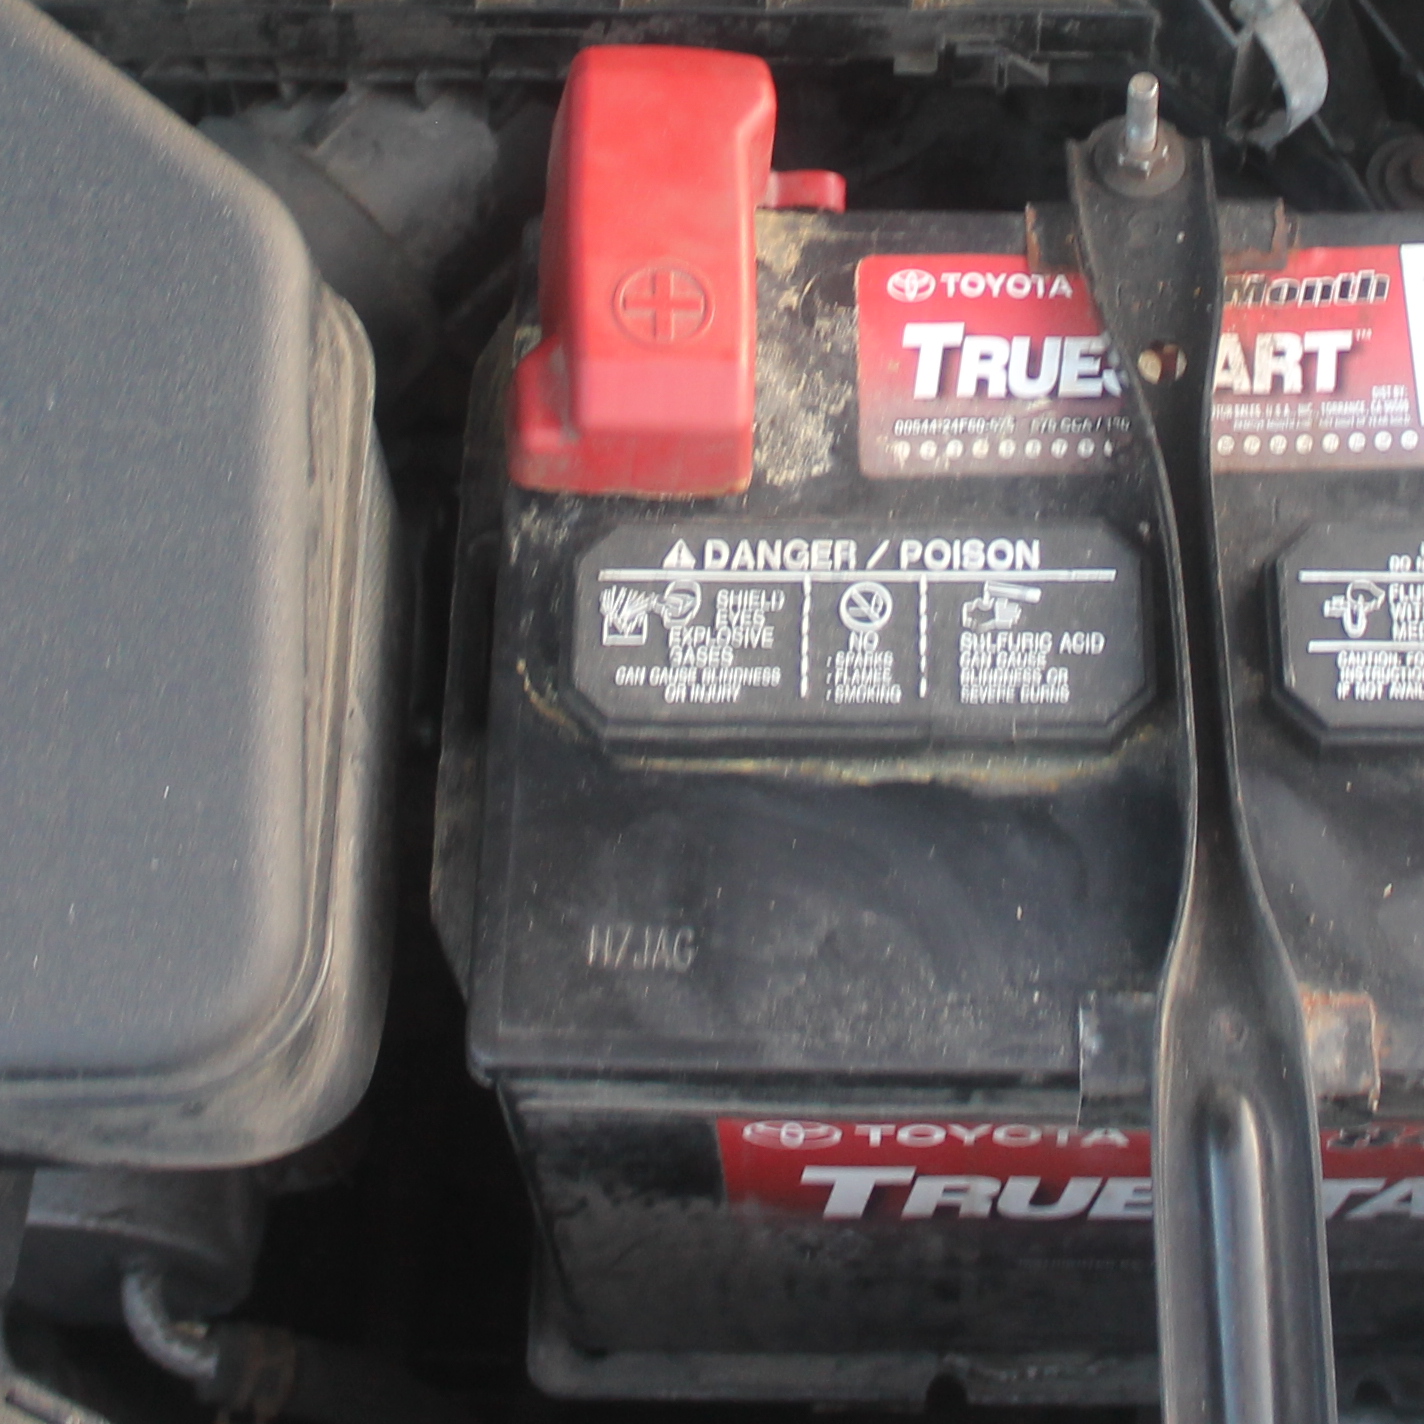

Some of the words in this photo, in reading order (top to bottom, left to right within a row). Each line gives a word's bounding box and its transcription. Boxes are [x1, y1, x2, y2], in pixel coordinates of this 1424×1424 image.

[940, 271, 1074, 299] TOYOTA
[704, 539, 858, 570] DANGER
[899, 539, 1040, 570] POISON
[716, 589, 785, 611] SHIELD
[716, 609, 766, 628] EYES
[668, 626, 775, 649] EXPLOSIVE
[849, 631, 879, 652] NO
[960, 631, 1053, 654] SULFURIC
[1059, 631, 1105, 654] ACID
[669, 645, 733, 668] GASES
[835, 651, 893, 669] SPARKS
[615, 666, 646, 687] CAN
[649, 666, 697, 687] CAUSE
[701, 666, 781, 687] BLINDNESS
[690, 684, 742, 704] INJURY
[835, 684, 902, 704] SMOKING
[855, 1122, 1129, 1148] TOYOTA
